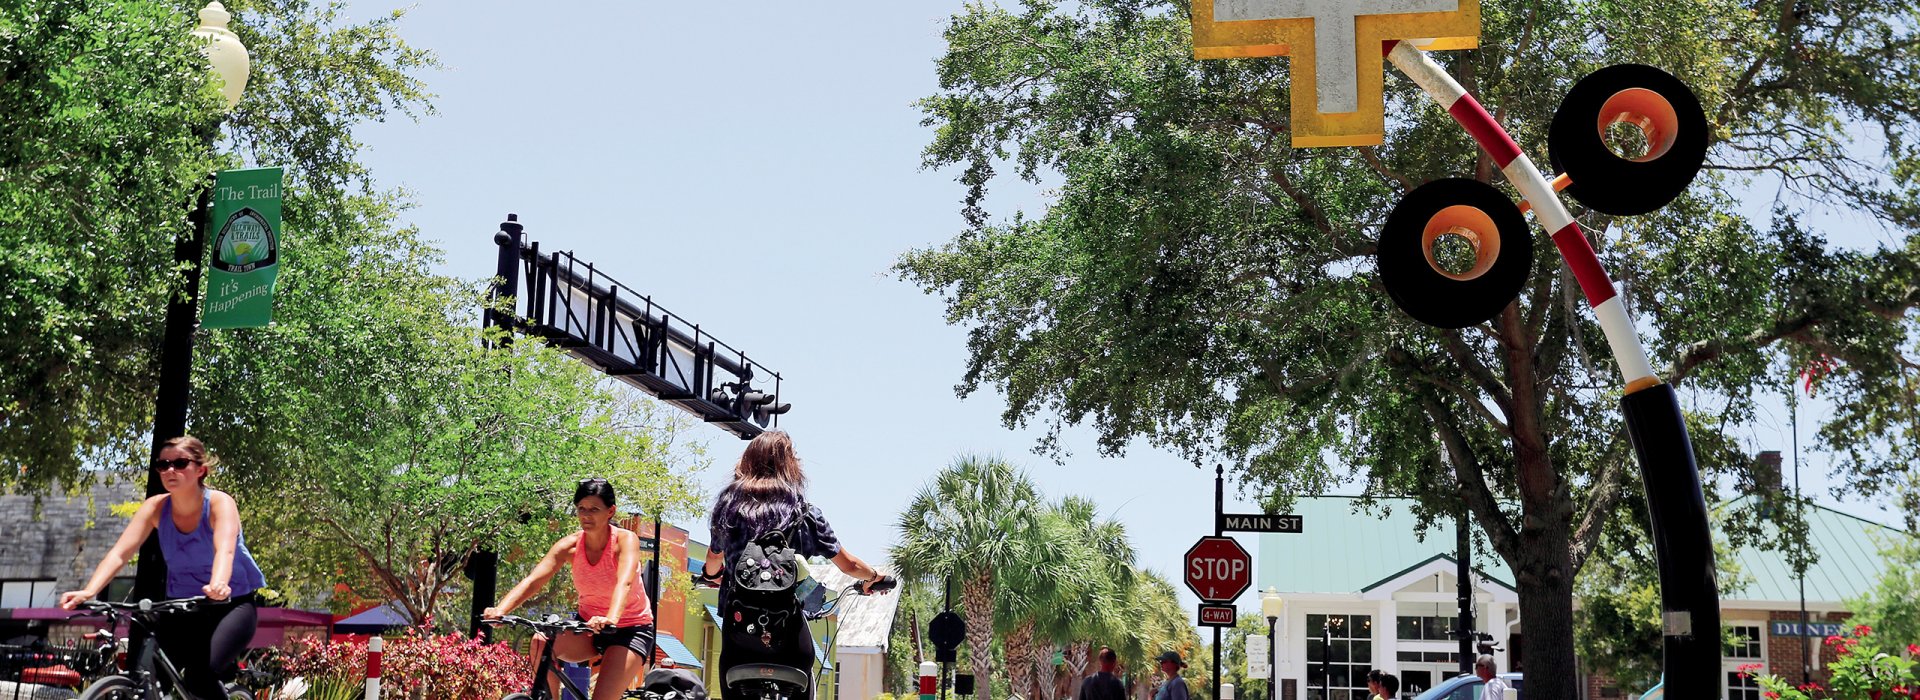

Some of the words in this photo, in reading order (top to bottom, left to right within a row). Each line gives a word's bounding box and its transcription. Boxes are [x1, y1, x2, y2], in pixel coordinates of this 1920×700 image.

[219, 187, 244, 200] The
[248, 184, 278, 199] Trail
[209, 284, 268, 313] Happening
[1226, 518, 1271, 529] MAIN
[1278, 518, 1299, 530] ST
[1191, 557, 1245, 581] STOP
[1204, 611, 1231, 620] 4-WAY
[1776, 622, 1843, 636] DUNE
